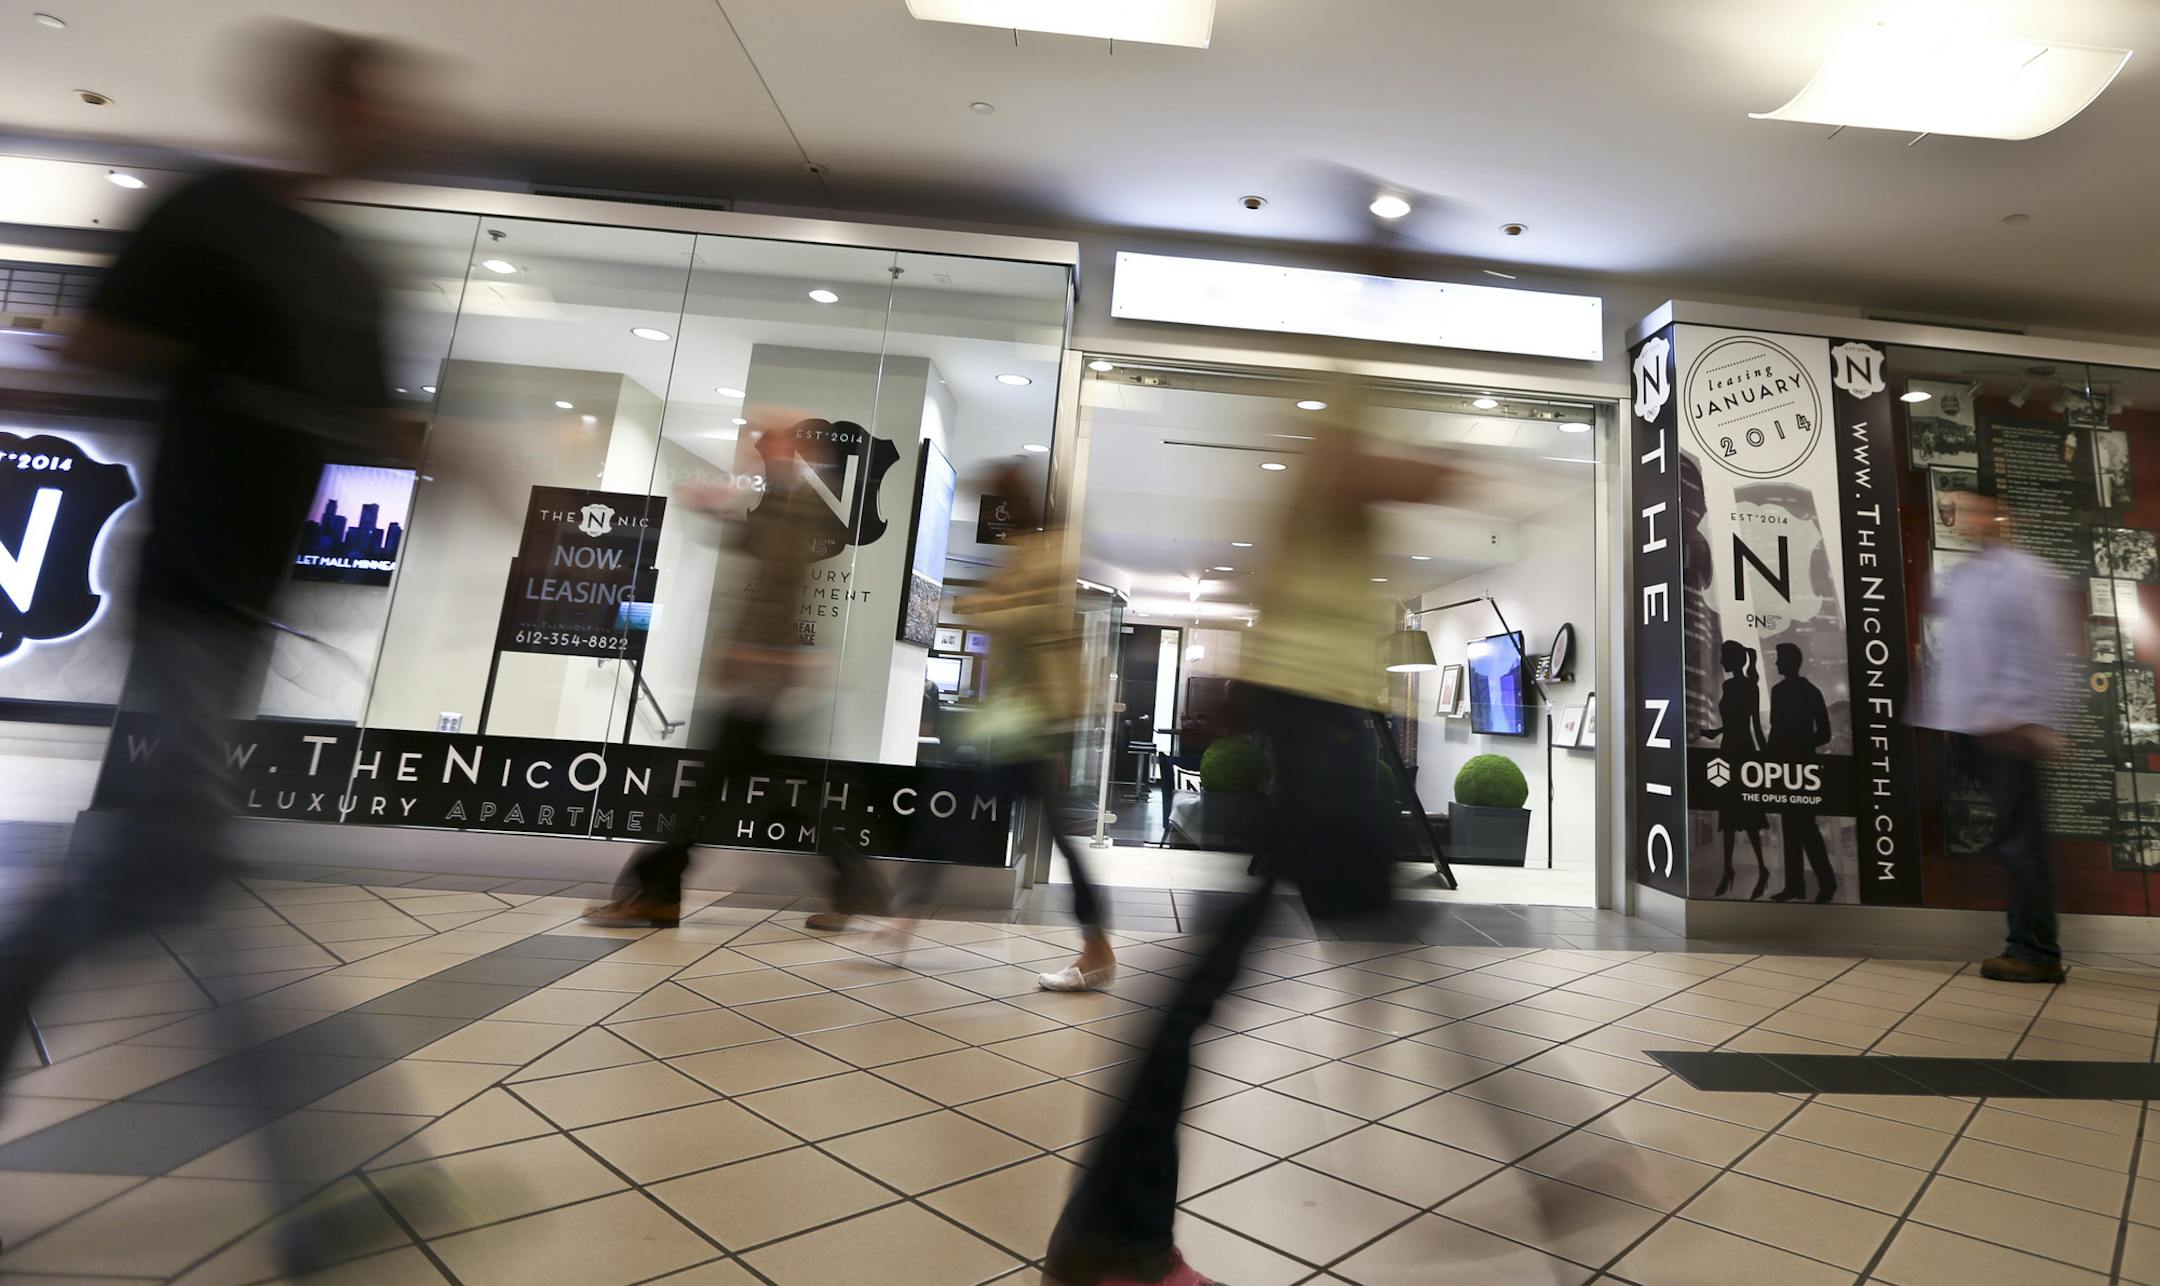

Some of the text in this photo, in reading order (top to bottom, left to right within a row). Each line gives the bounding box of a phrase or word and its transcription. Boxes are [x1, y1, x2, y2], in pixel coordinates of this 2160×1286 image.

[1643, 355, 1661, 404] N
[1708, 364, 1774, 391] leasing
[1846, 355, 1872, 385] N
[1694, 373, 1803, 419] JANUARY
[1720, 413, 1811, 457] 2014
[540, 509, 577, 523] THE
[618, 516, 650, 528] NIC
[1641, 428, 1670, 625] THE
[554, 545, 623, 571] NOW
[1733, 532, 1790, 604] N
[526, 577, 637, 606] LEASING
[516, 630, 629, 651] 612-354-8822
[1645, 699, 1674, 878] NIC
[1740, 760, 1821, 791] OPUS
[1742, 793, 1822, 805] THE OPUS GROUP
[248, 788, 418, 818] LUXURY
[736, 820, 872, 847] HOMS
